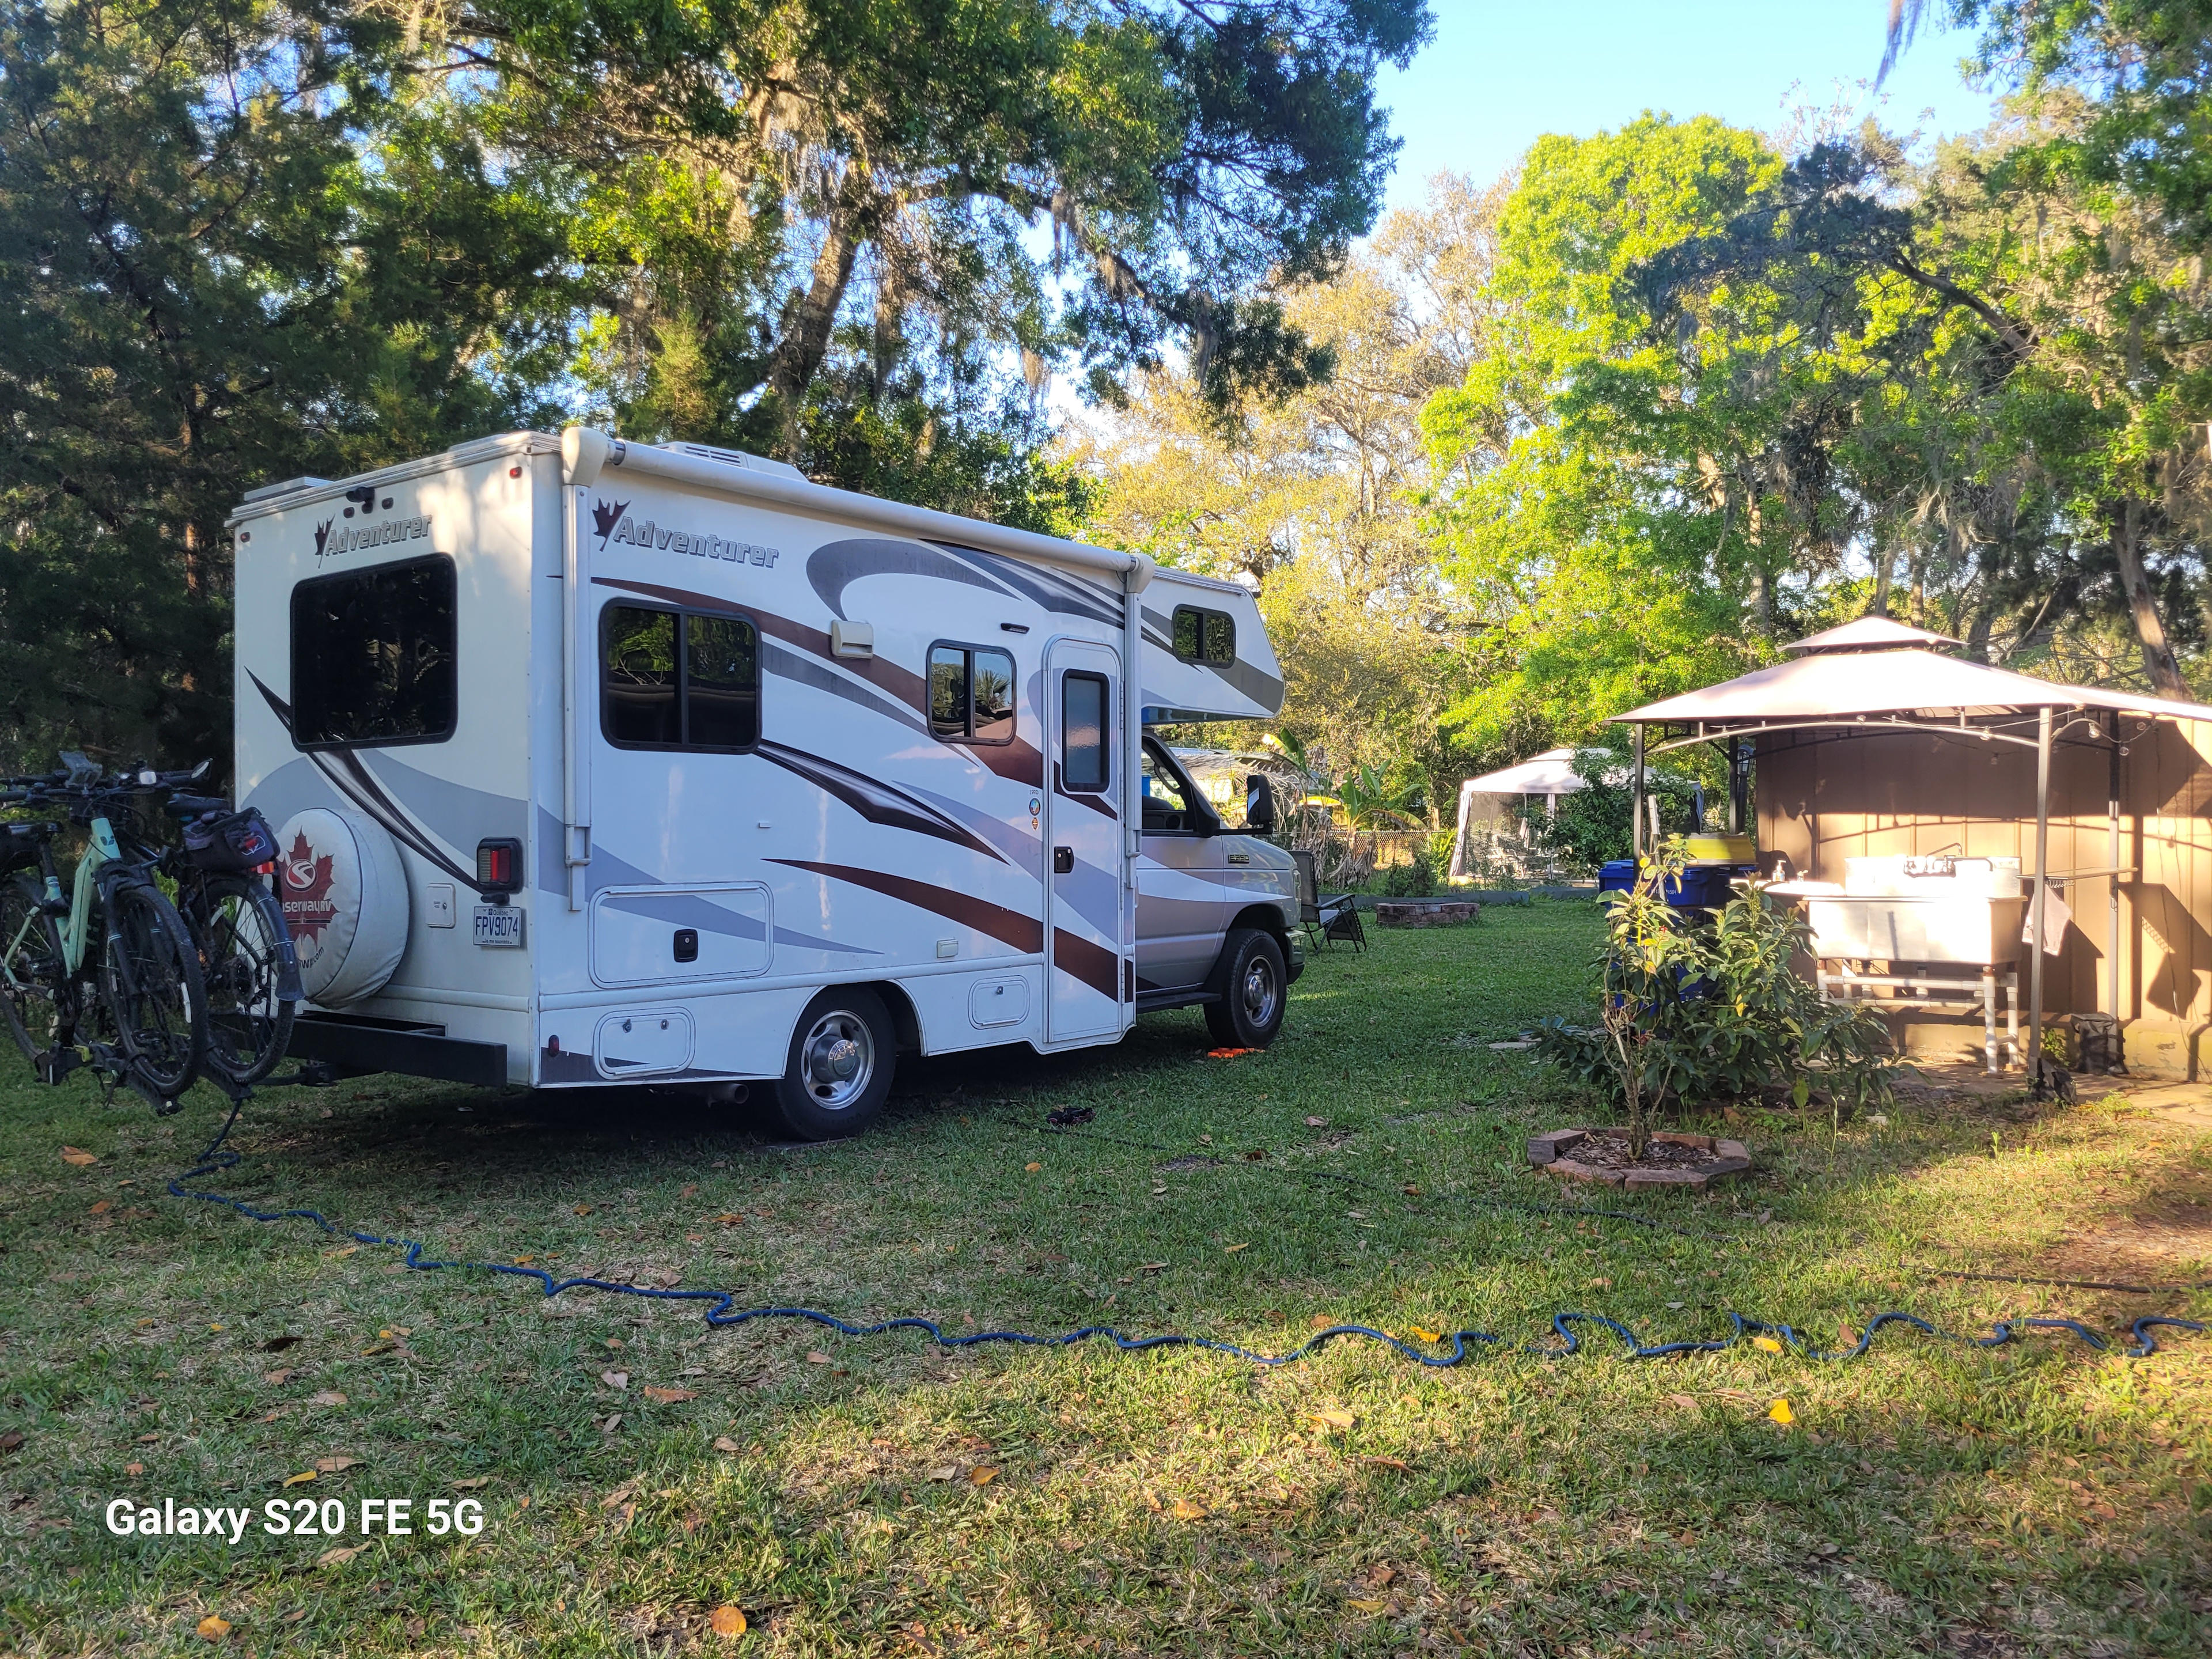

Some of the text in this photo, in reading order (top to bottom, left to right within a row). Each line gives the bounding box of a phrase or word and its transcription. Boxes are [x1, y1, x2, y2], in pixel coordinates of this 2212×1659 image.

[325, 514, 432, 556] Adventurer
[613, 516, 779, 569] Adventurer
[282, 900, 331, 914] serwayRV
[475, 916, 518, 937] FPV9074
